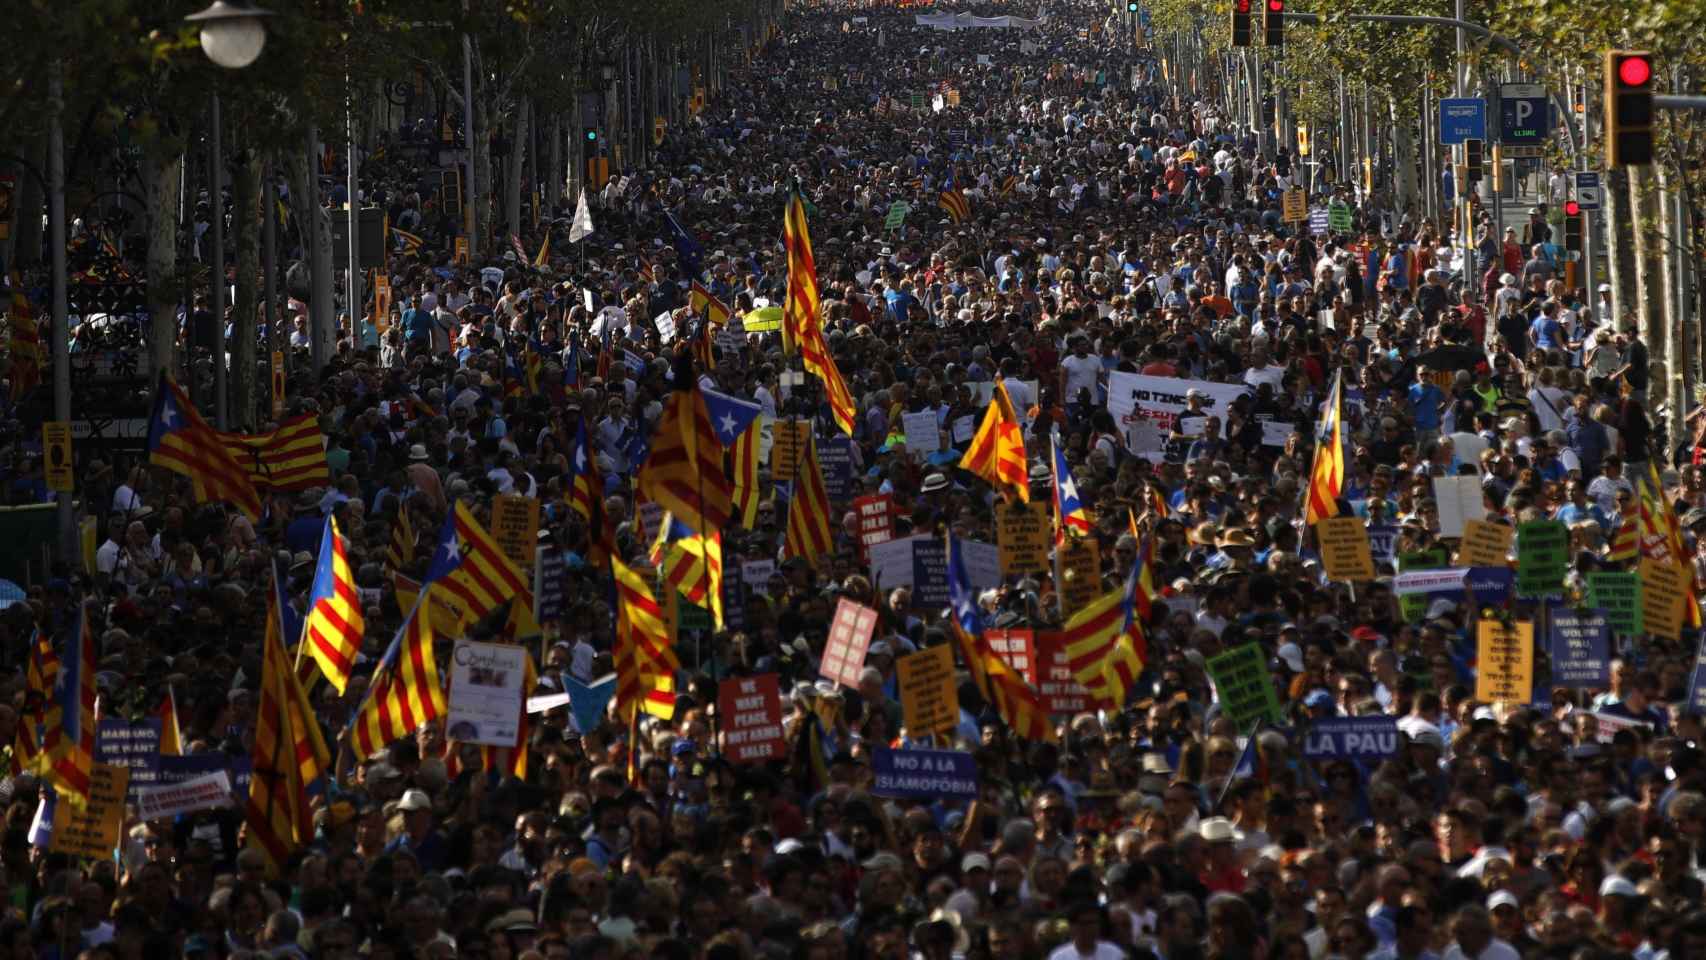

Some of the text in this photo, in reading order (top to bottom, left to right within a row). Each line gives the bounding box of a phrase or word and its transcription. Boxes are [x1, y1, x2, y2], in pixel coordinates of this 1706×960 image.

[1516, 101, 1533, 127] P
[1455, 127, 1472, 135] taxi
[1132, 389, 1150, 401] NO
[740, 680, 757, 694] WE
[735, 695, 765, 711] WANT
[734, 709, 770, 728] PEACE
[101, 743, 156, 753] WE WANT
[739, 742, 774, 760] SALES
[1305, 732, 1397, 754] LA PAU
[893, 755, 956, 773] NO A LA
[131, 771, 157, 781] RMS
